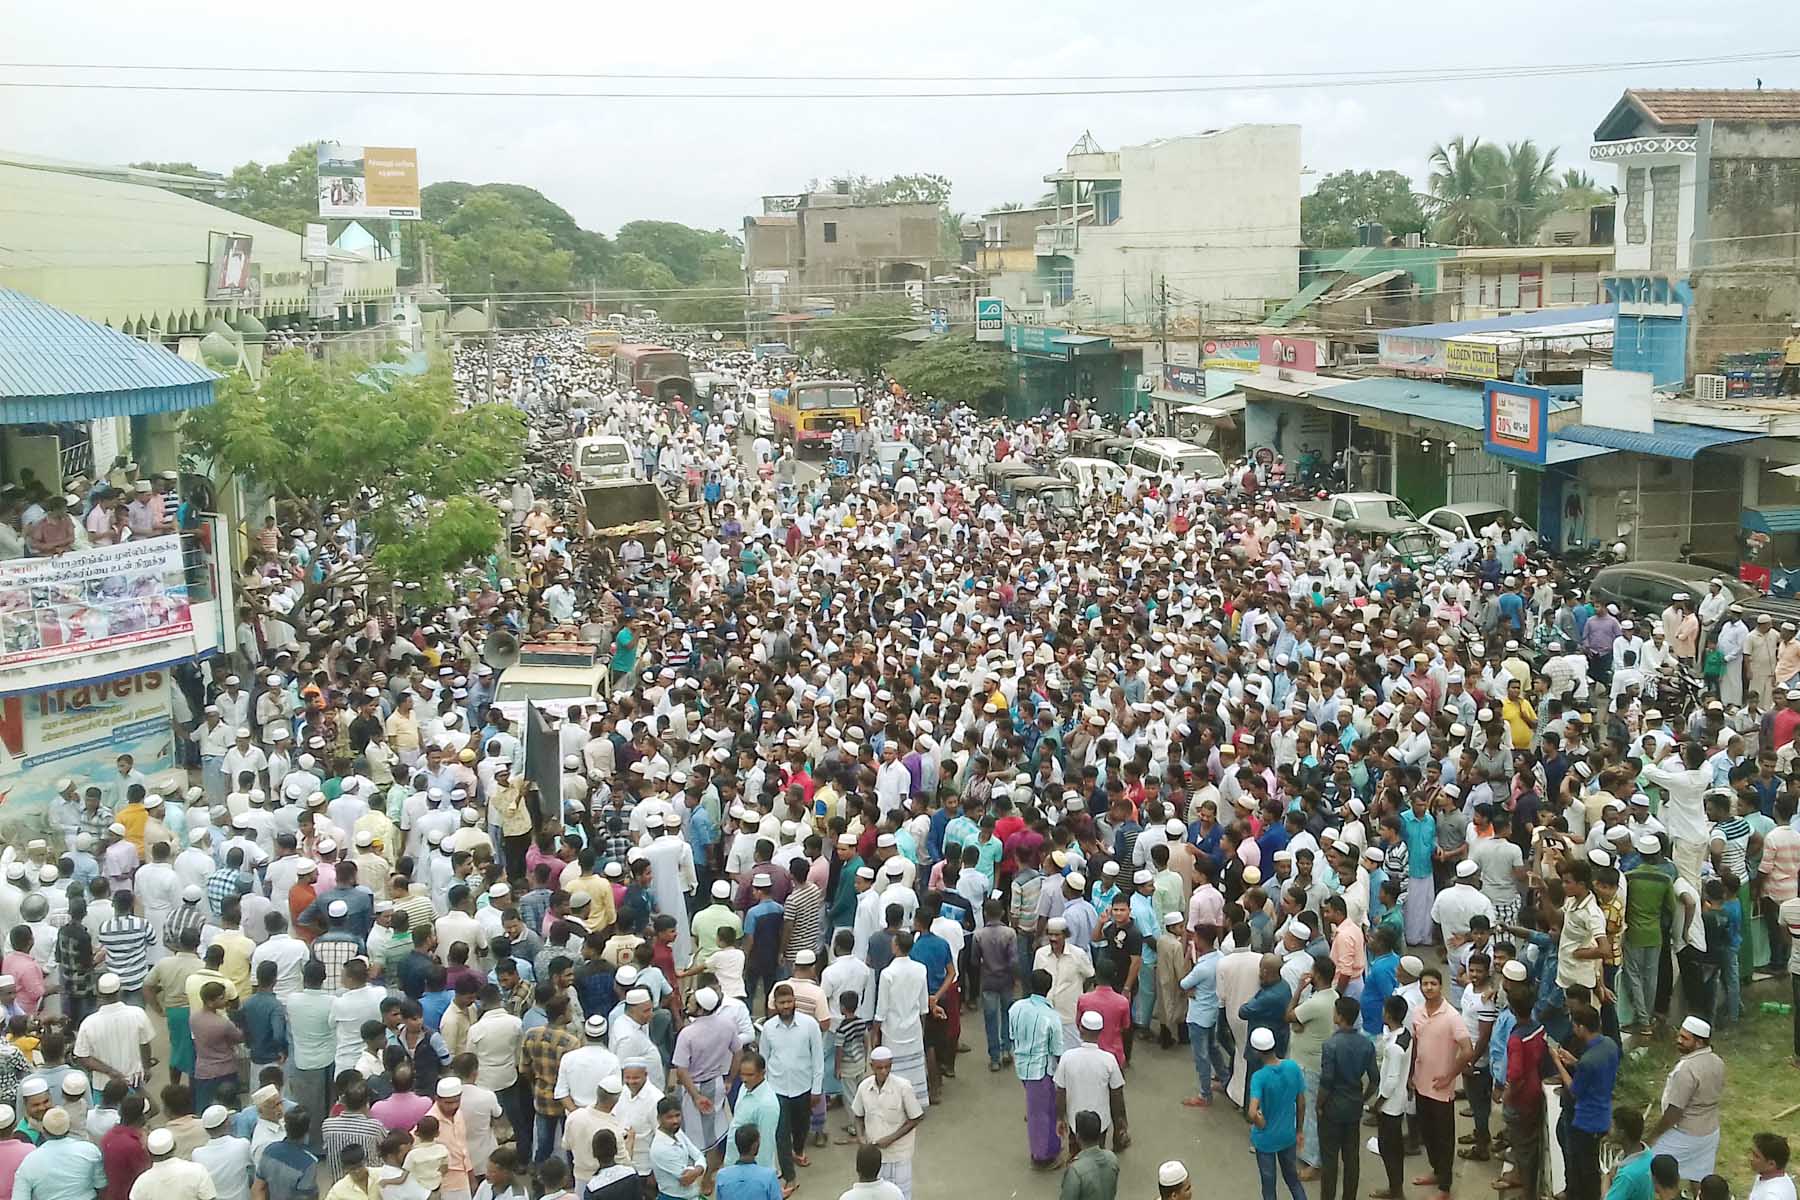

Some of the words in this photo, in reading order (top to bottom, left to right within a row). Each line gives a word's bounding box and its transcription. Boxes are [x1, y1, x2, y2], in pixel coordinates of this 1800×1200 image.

[980, 320, 1002, 329] RDB
[1282, 344, 1296, 362] LG
[1472, 349, 1496, 364] TEXTILE
